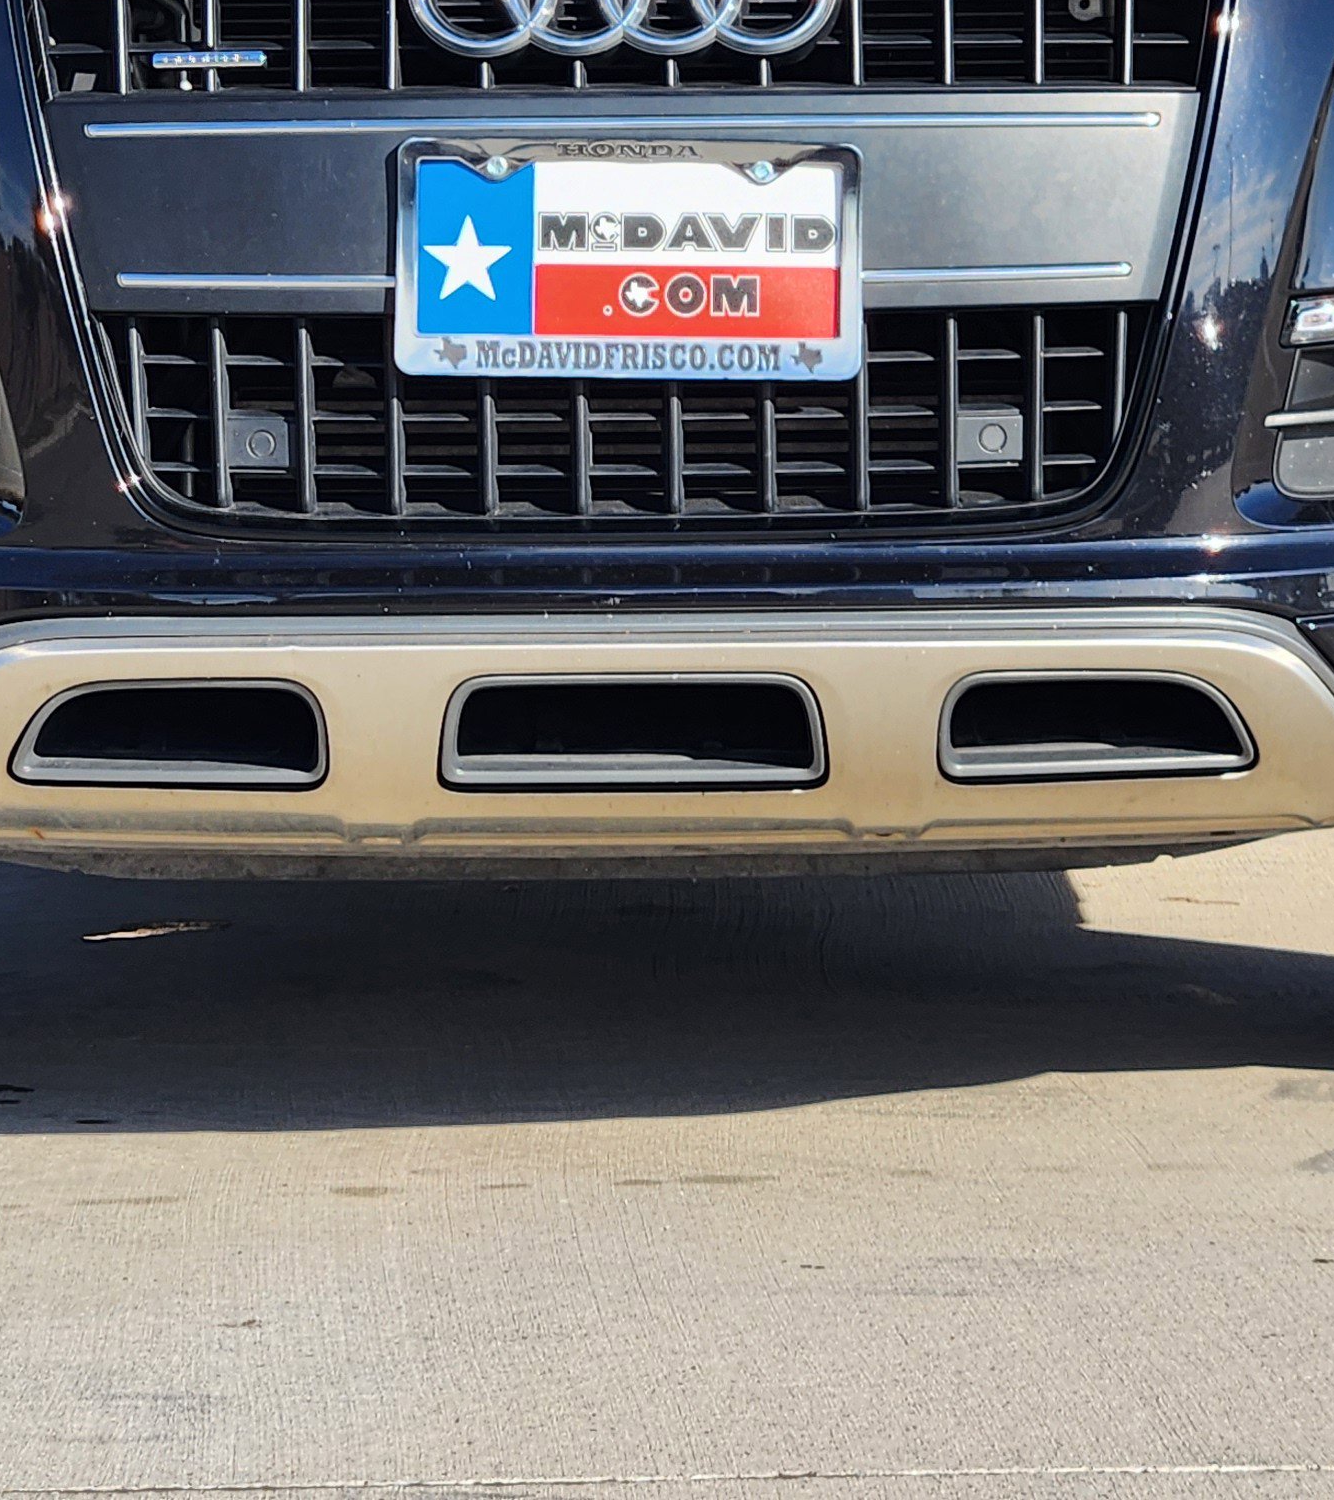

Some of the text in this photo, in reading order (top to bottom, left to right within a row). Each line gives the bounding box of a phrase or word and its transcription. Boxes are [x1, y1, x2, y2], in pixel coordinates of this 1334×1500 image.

[556, 142, 701, 158] HONDA
[603, 272, 761, 318] .COM
[475, 340, 781, 372] McDAVIDFRISCO.COM
